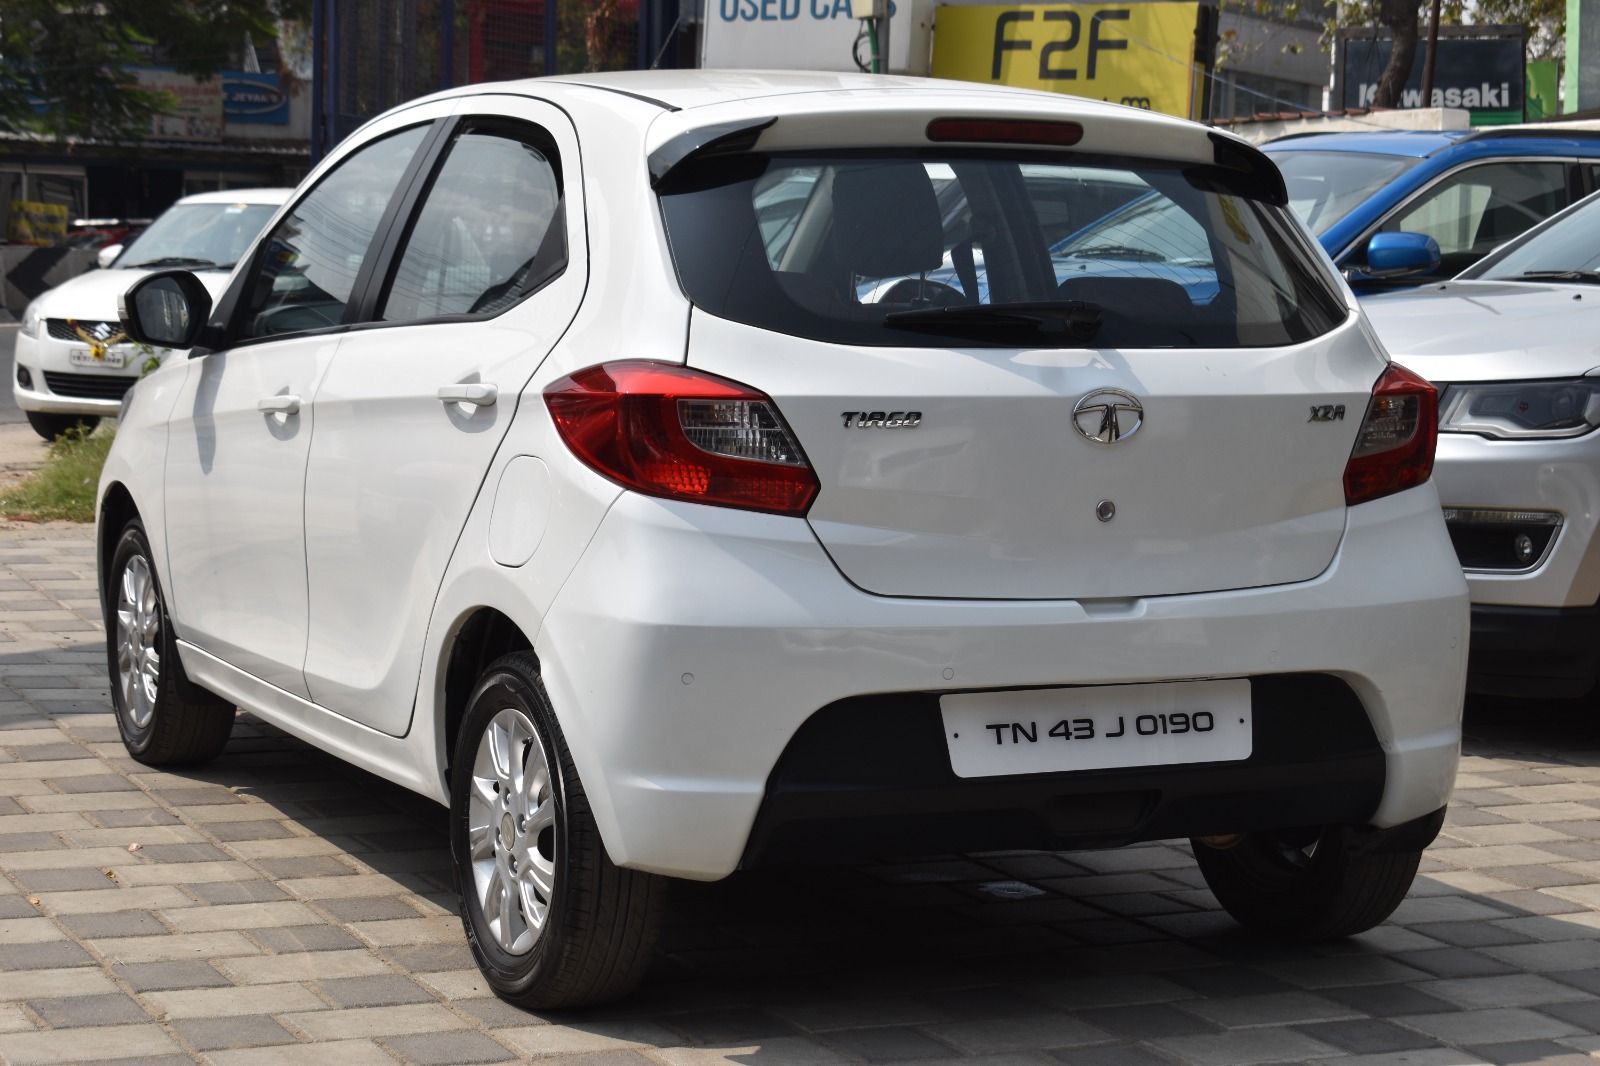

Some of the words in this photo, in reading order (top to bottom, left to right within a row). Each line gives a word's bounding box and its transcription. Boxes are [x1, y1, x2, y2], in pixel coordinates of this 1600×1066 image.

[810, 0, 897, 20] CA
[991, 9, 1131, 80] F2F
[1358, 82, 1510, 109] Kwasaki
[841, 411, 922, 428] TIAGO
[986, 721, 1038, 745] TN
[1048, 718, 1095, 741] 43
[1106, 716, 1125, 738] J
[1135, 711, 1215, 736] 0190
